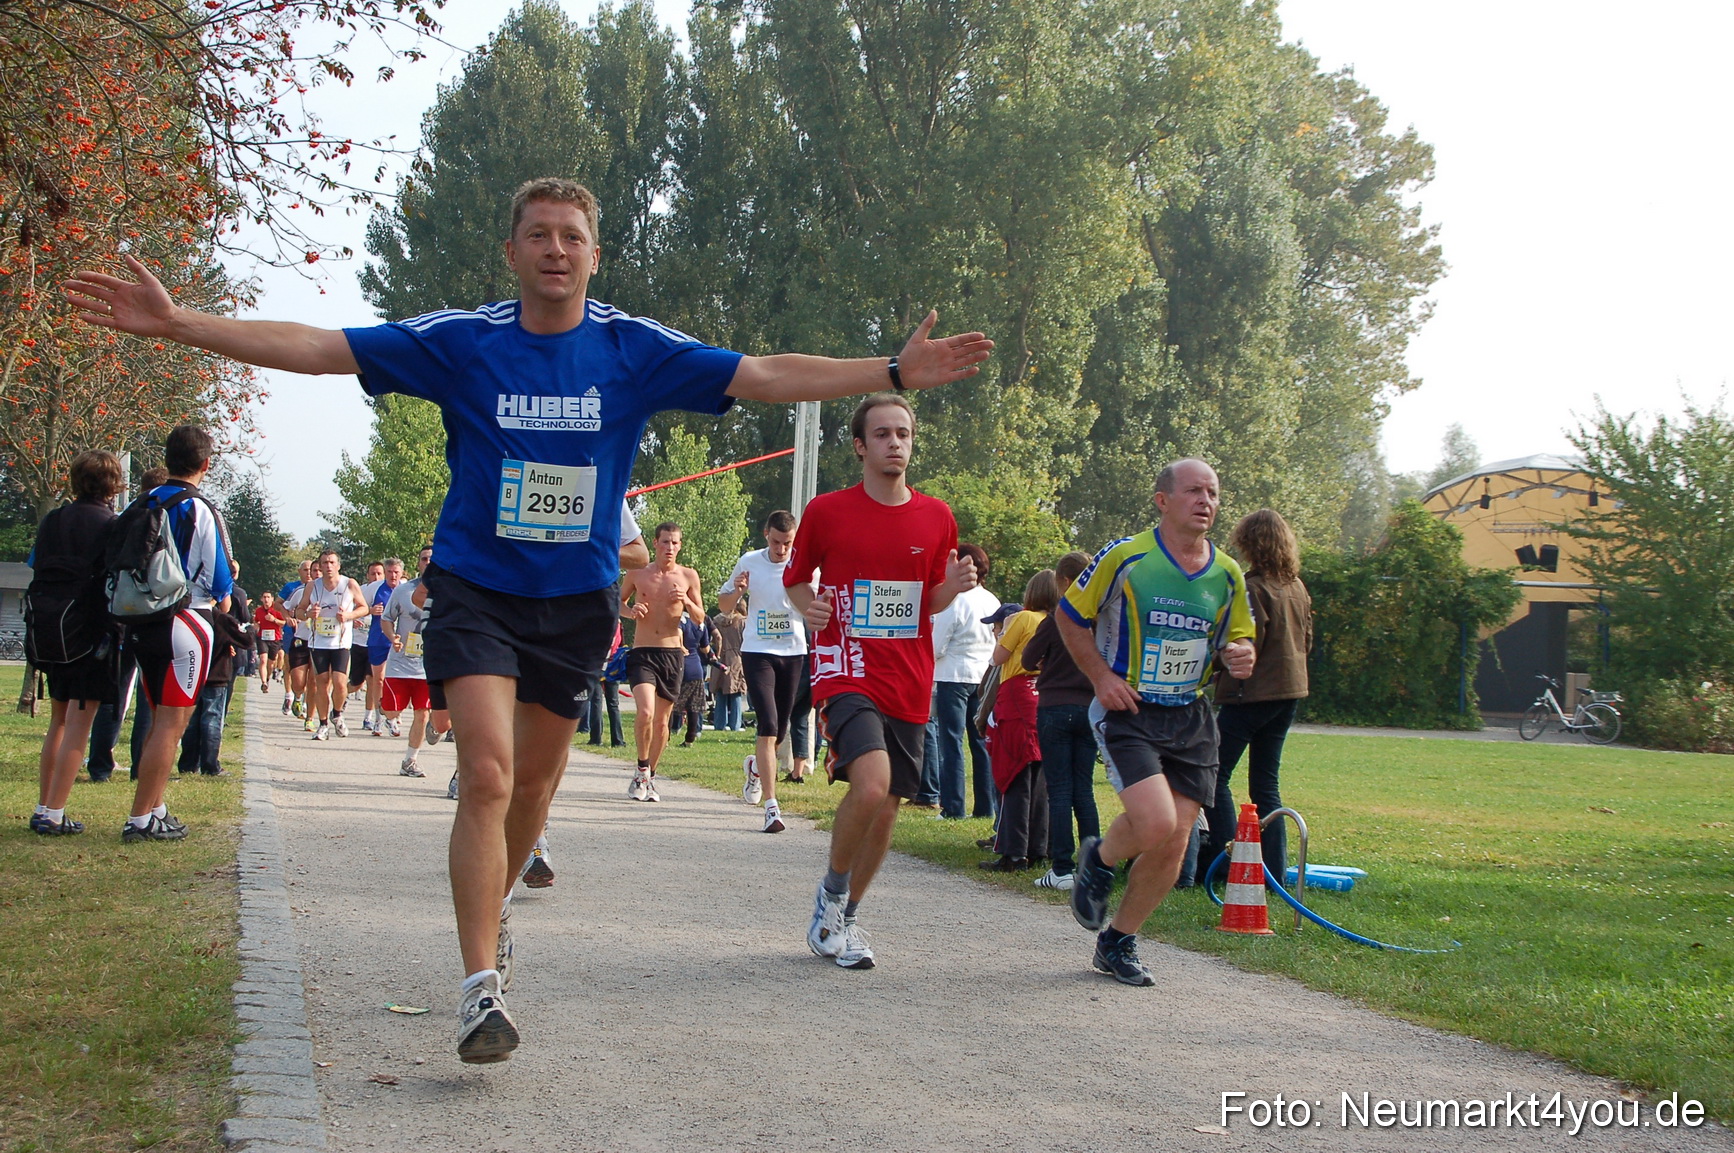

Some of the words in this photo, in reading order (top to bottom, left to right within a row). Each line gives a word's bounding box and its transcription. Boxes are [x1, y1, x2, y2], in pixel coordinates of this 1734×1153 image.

[496, 394, 602, 419] HUBER
[518, 419, 599, 429] TECHNOLOGY
[528, 469, 563, 486] Anton
[505, 488, 512, 499] B
[526, 492, 585, 515] 2936
[874, 585, 902, 597] Stefan
[874, 602, 913, 618] 3568
[1152, 596, 1185, 608] TEAM
[768, 620, 791, 630] 2463
[1149, 610, 1212, 633] BOCK
[1164, 645, 1188, 656] Victor
[848, 640, 865, 678] MAX
[1162, 660, 1199, 676] 3177
